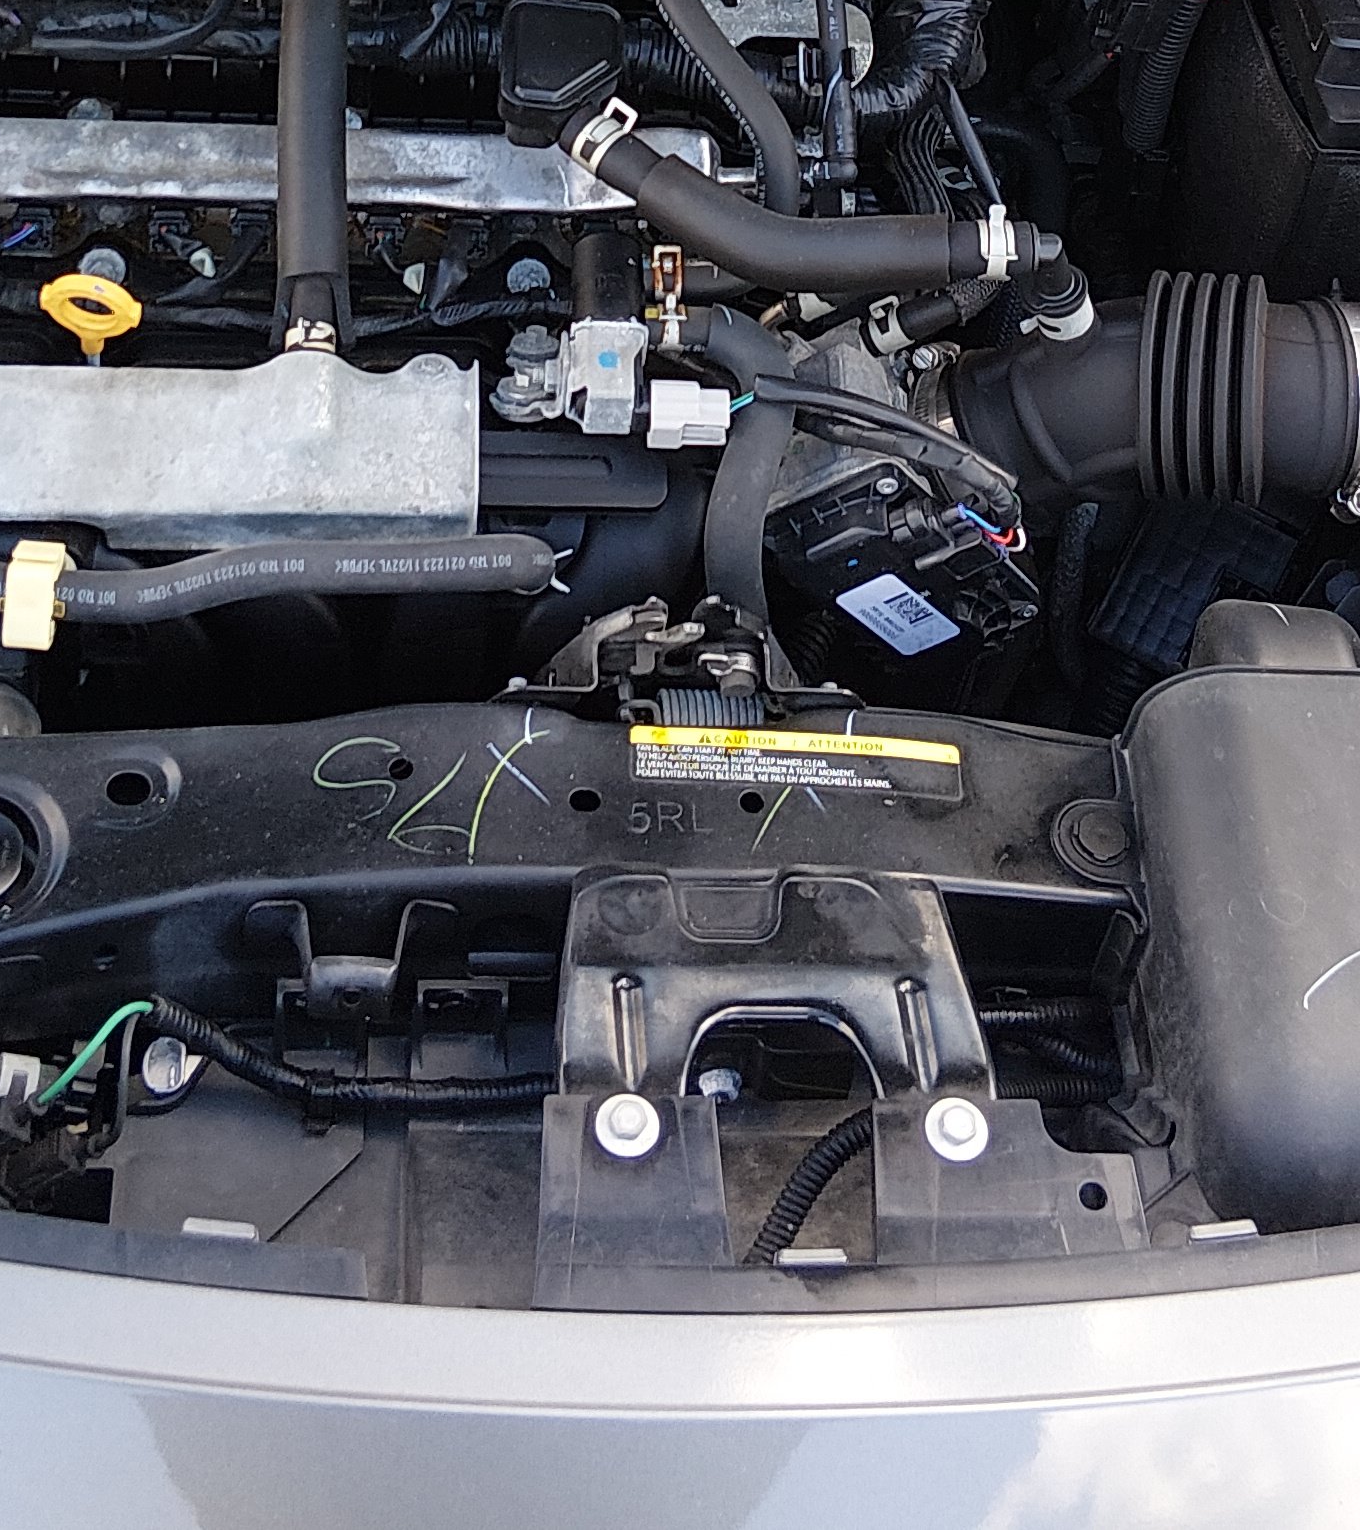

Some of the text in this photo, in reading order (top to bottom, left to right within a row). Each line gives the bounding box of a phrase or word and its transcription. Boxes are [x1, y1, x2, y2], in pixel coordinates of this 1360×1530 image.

[636, 743, 652, 752] FAN
[677, 745, 693, 753] CAN
[714, 733, 777, 746] CAUTION
[808, 739, 884, 752] ATTENTION
[649, 752, 667, 760] HELP
[777, 758, 802, 766] HANDS
[769, 774, 785, 783] PAS
